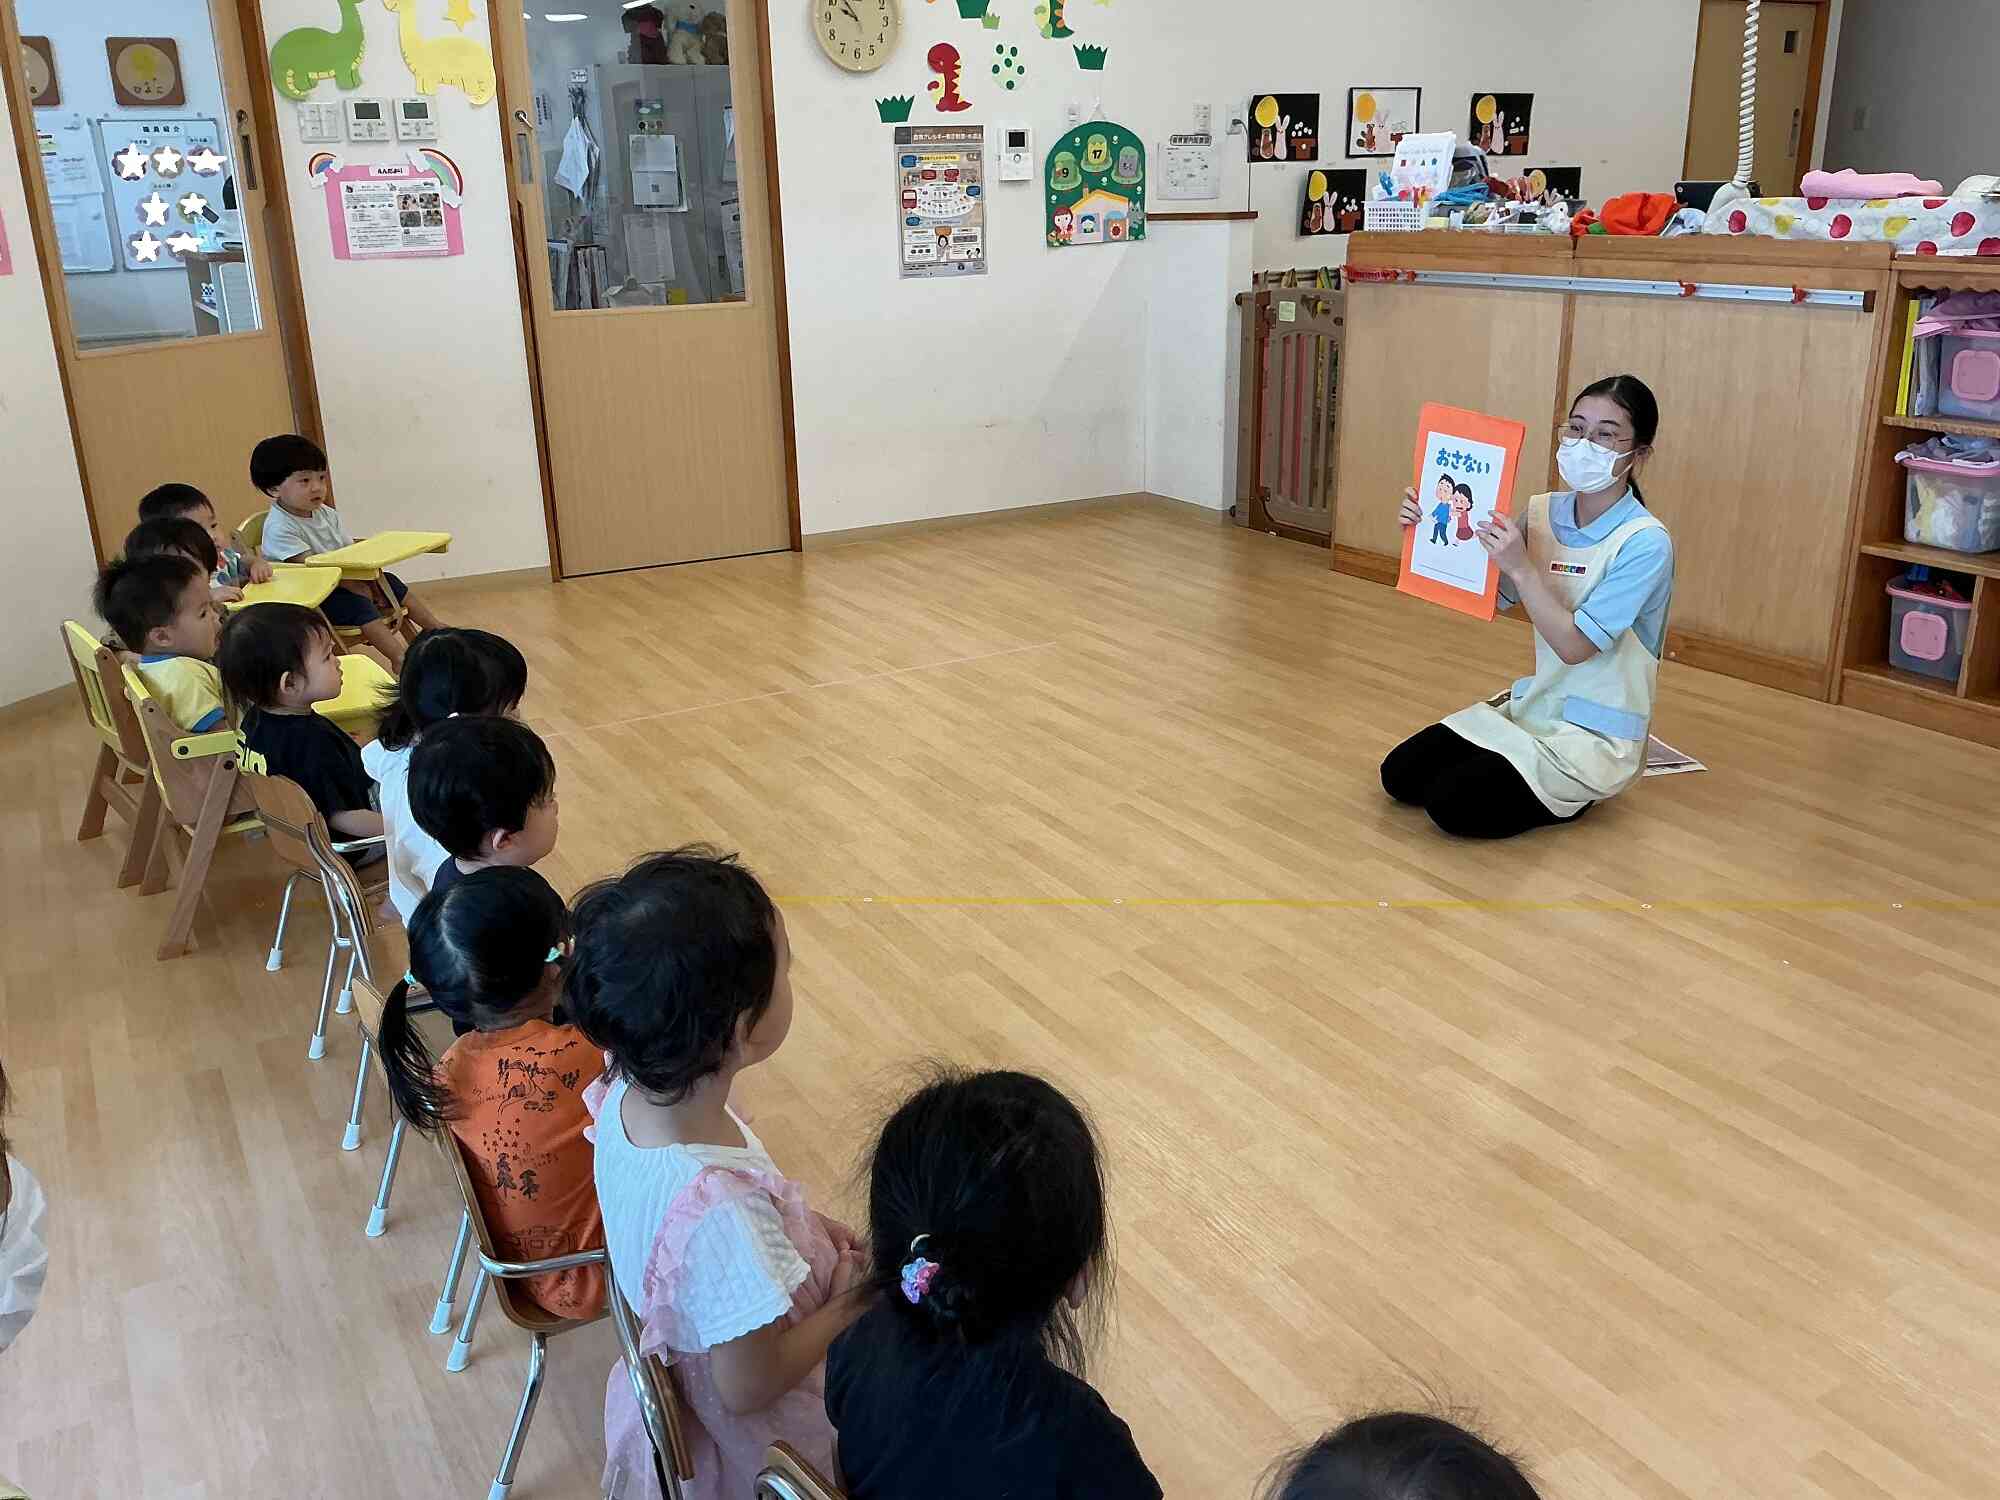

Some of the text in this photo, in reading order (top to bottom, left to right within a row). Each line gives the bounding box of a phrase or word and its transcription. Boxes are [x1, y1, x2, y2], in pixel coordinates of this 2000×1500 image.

[824, 11, 832, 23] 9
[882, 16, 889, 27] 3
[829, 29, 836, 40] 8
[877, 33, 884, 43] 4
[840, 43, 846, 54] 7
[854, 48, 861, 59] 6
[868, 45, 875, 56] 5
[1092, 149, 1103, 159] 17
[1061, 168, 1069, 178] 9
[1436, 448, 1490, 474] おさない
